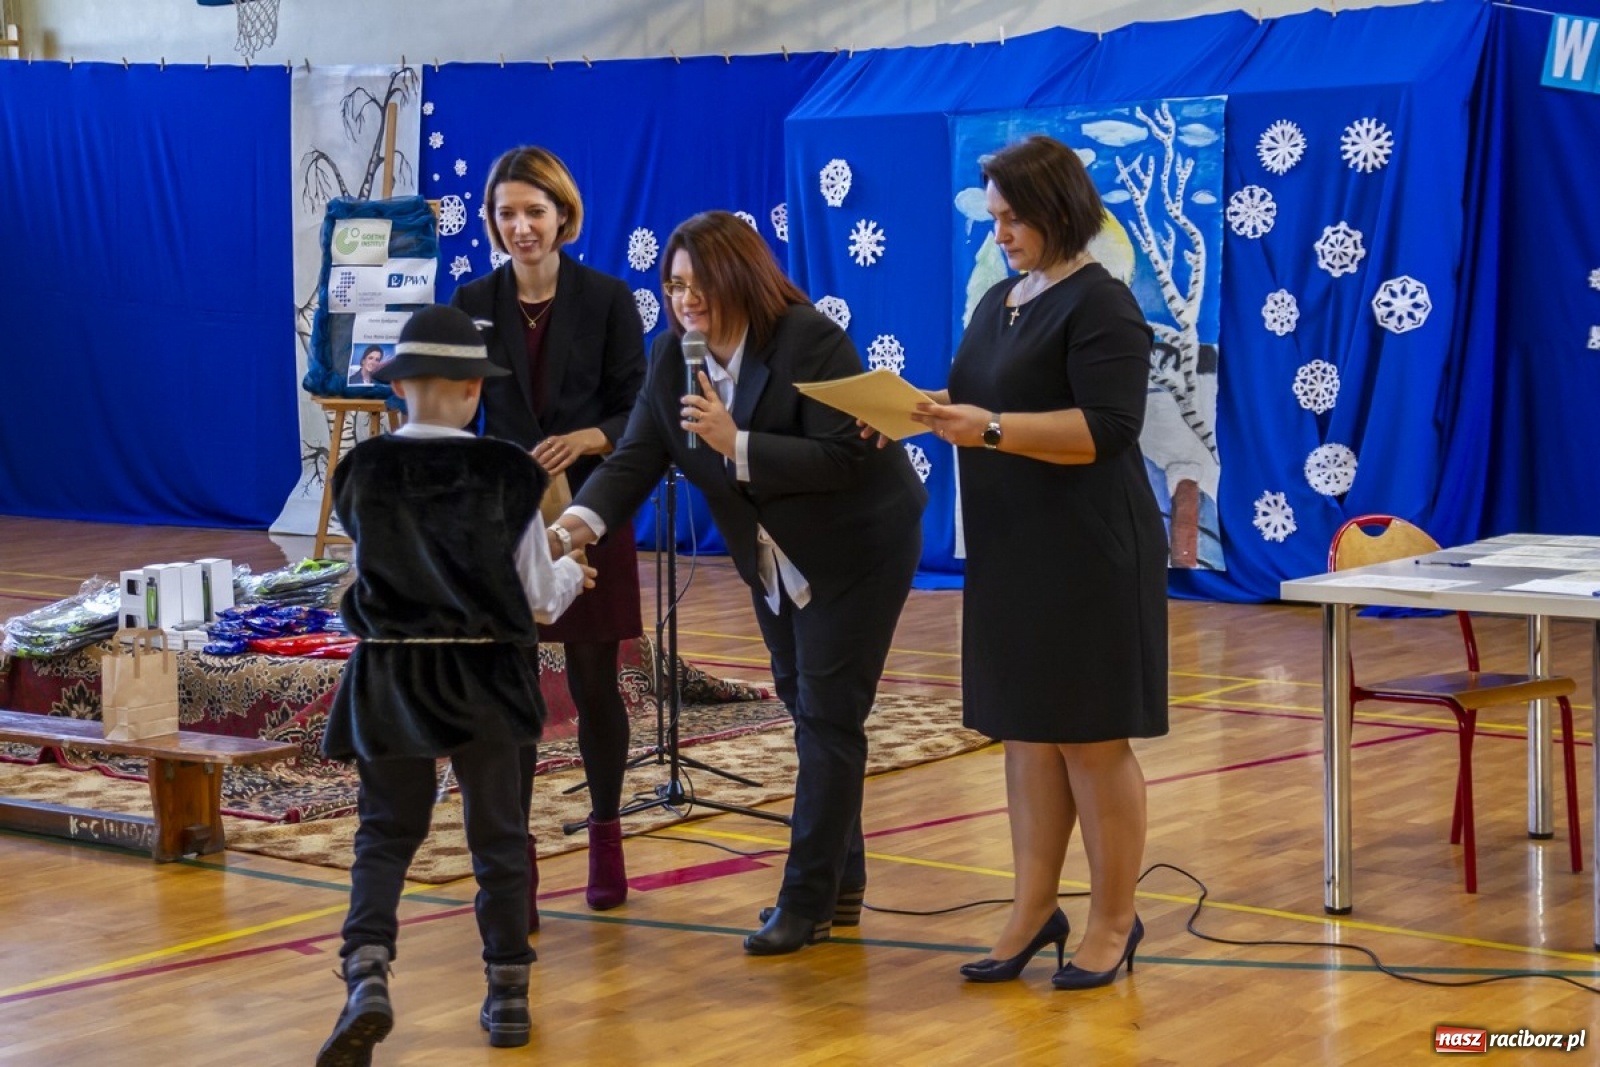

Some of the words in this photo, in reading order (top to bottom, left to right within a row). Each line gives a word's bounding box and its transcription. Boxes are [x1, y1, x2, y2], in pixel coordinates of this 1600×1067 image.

[361, 233, 386, 241] GOETHE
[361, 240, 386, 248] INSTITUT
[404, 275, 428, 286] PWN
